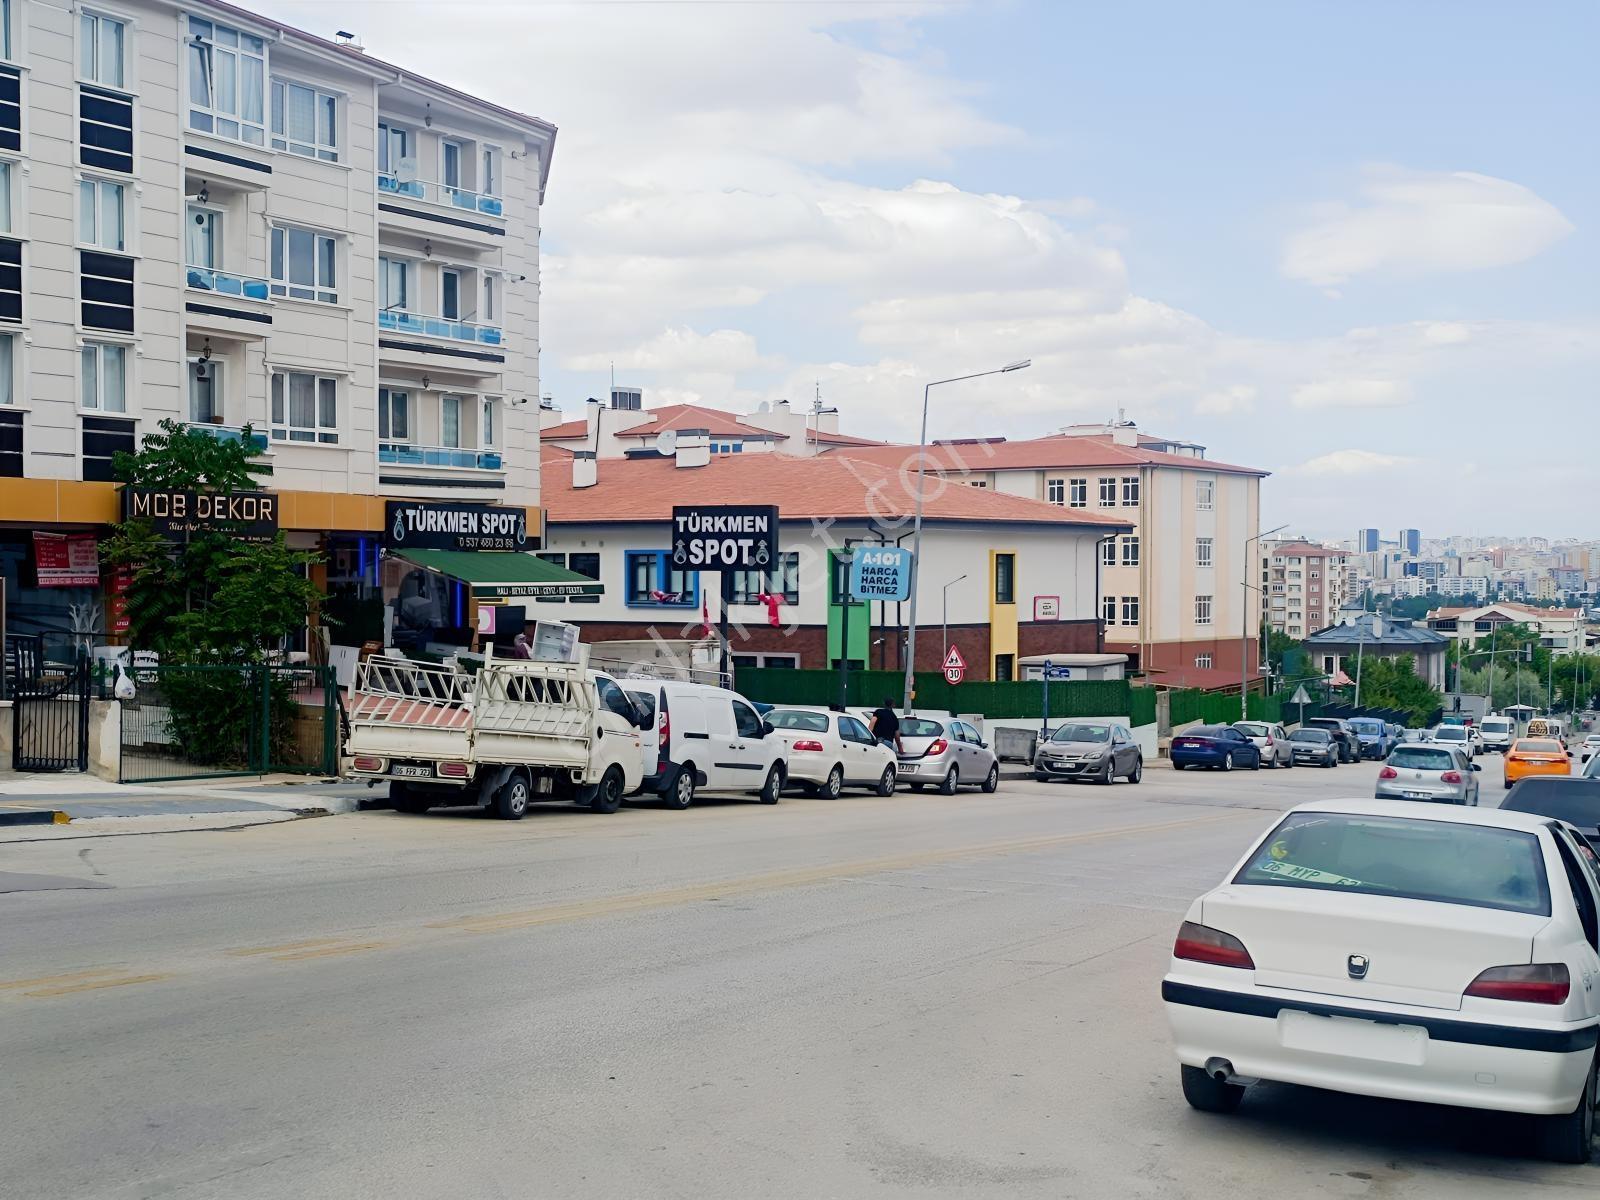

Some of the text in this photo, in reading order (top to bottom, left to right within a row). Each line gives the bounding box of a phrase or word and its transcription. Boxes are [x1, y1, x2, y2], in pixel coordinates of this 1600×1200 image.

[133, 492, 272, 521] MOB DEKOR
[405, 505, 517, 535] TÜRKMEN SPOT
[675, 511, 768, 533] TÜRKMEN
[688, 538, 754, 565] SPOT
[861, 566, 899, 577] HARCA
[861, 576, 898, 586] HARCA
[947, 669, 960, 679] 30
[1262, 861, 1285, 872] 06
